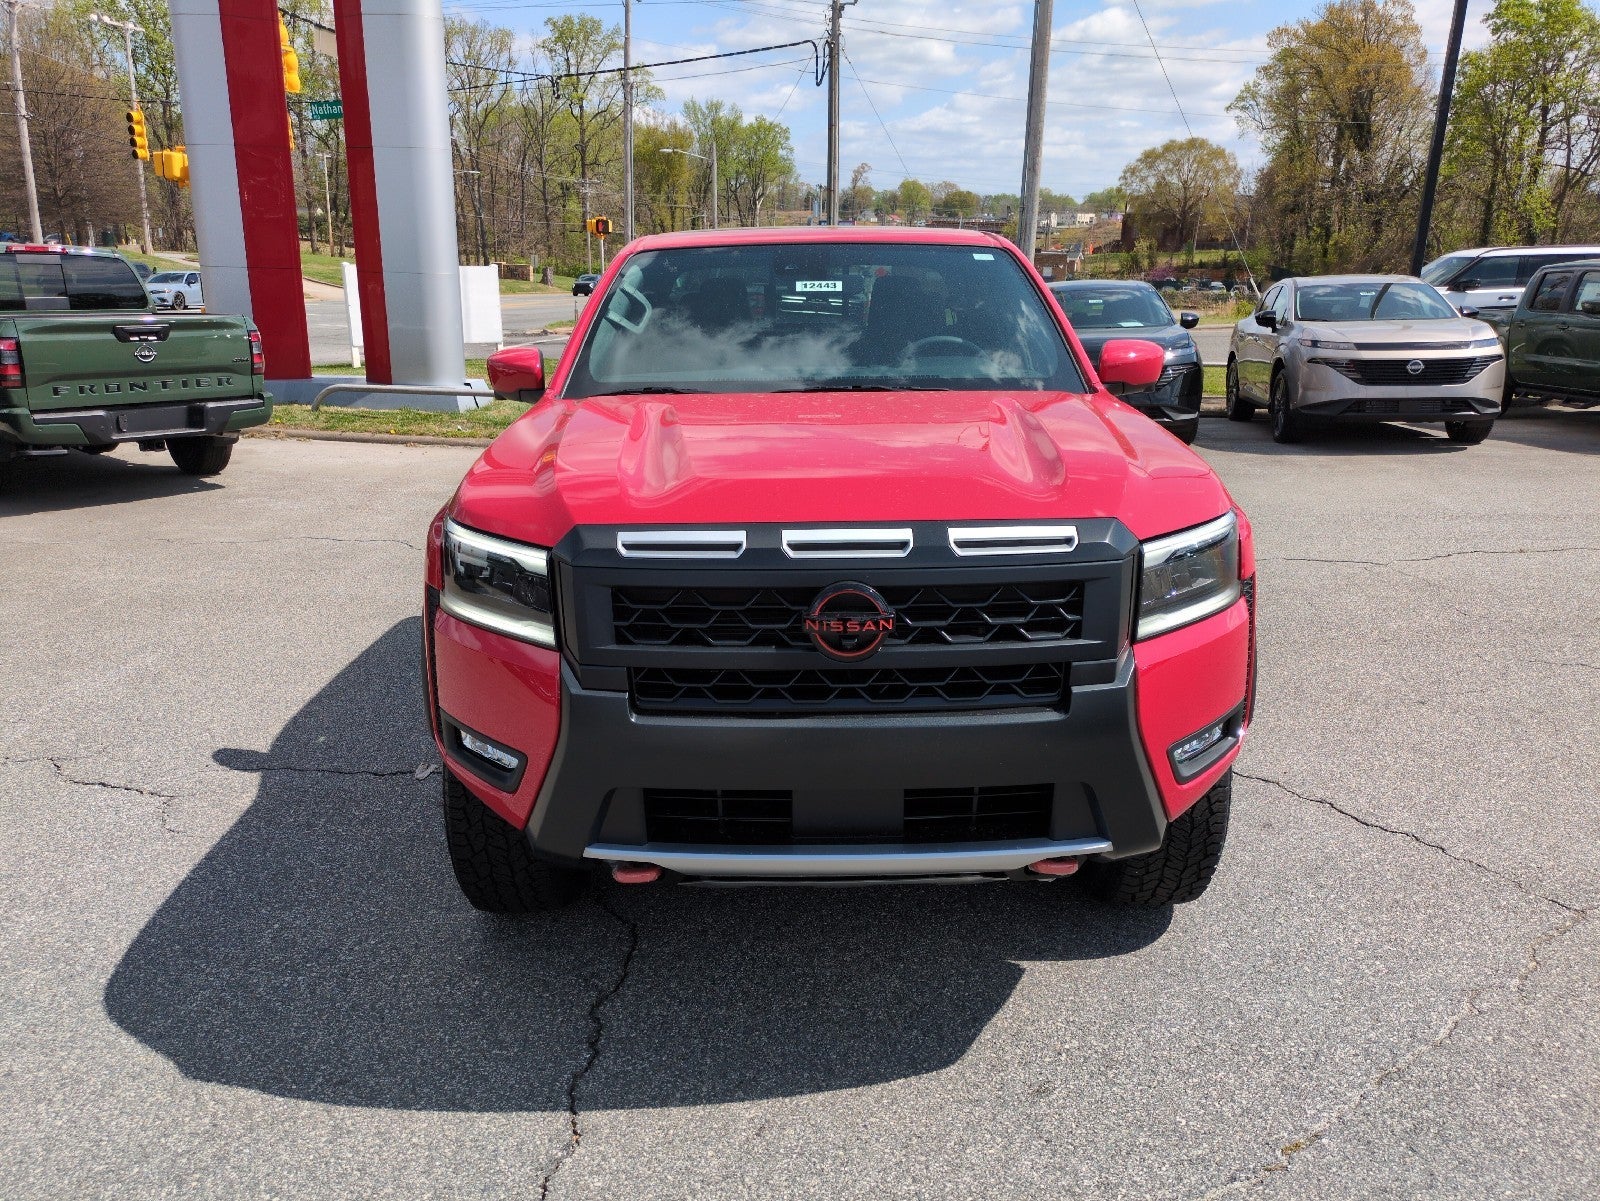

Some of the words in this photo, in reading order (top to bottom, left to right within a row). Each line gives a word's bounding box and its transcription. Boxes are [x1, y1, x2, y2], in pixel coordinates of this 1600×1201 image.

[312, 103, 343, 115] Nathan
[52, 377, 234, 397] FRONTIER
[805, 618, 893, 632] NISSAN
